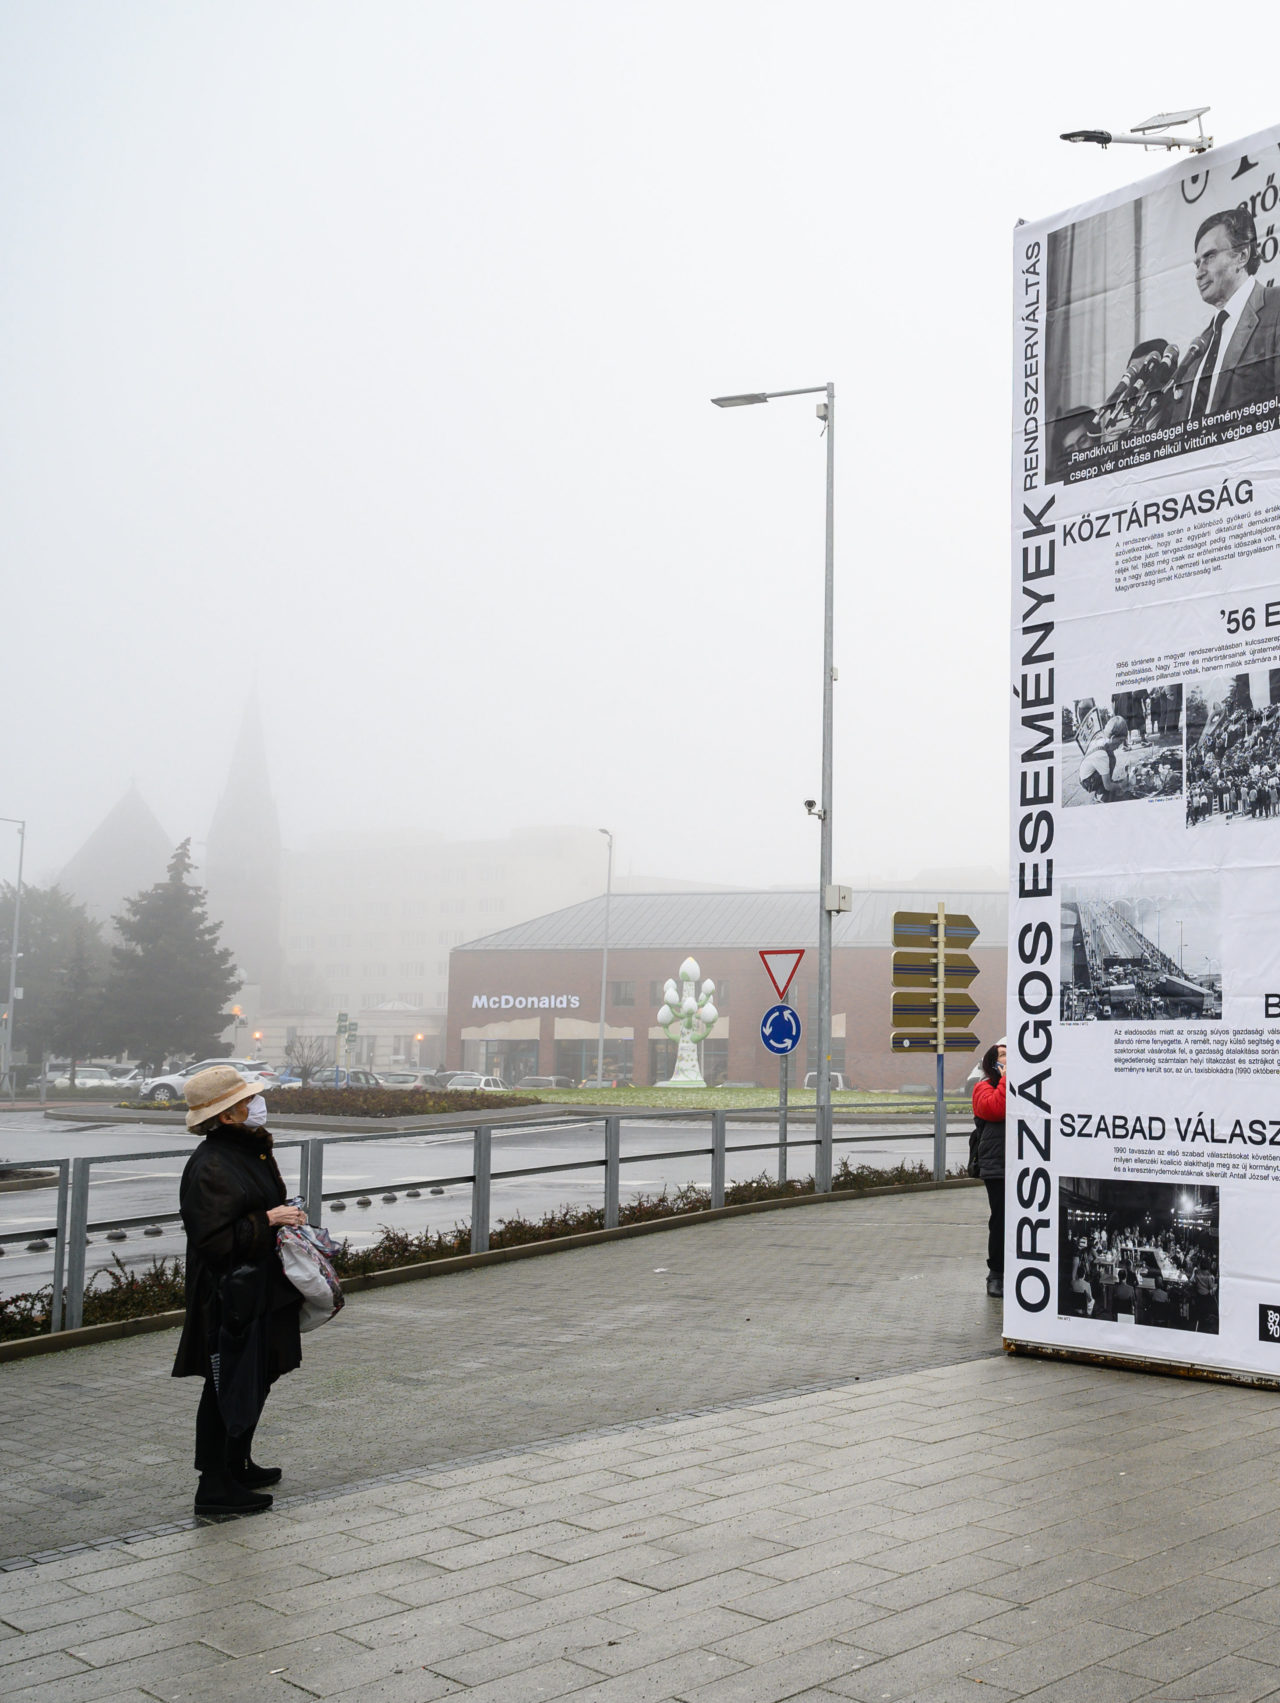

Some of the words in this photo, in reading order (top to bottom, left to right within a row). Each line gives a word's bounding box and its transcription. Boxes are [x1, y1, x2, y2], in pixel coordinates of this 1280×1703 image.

[1023, 240, 1042, 492] RENDSZERVÁLTÁS
[1069, 465, 1098, 480] csepp
[1118, 451, 1151, 467] ontása
[1153, 440, 1182, 458] nélkül
[1184, 430, 1218, 450] vittünk
[1221, 423, 1253, 440] végbe
[1121, 422, 1184, 449] tudatosággal
[1202, 397, 1280, 427] keménységgel,
[1063, 478, 1254, 546] KÖZTÁRSASÁG
[1013, 494, 1057, 898] ESEMÉNYEK
[1010, 920, 1055, 1312] ORSZÁGOS
[1060, 1113, 1166, 1141] SZABAD
